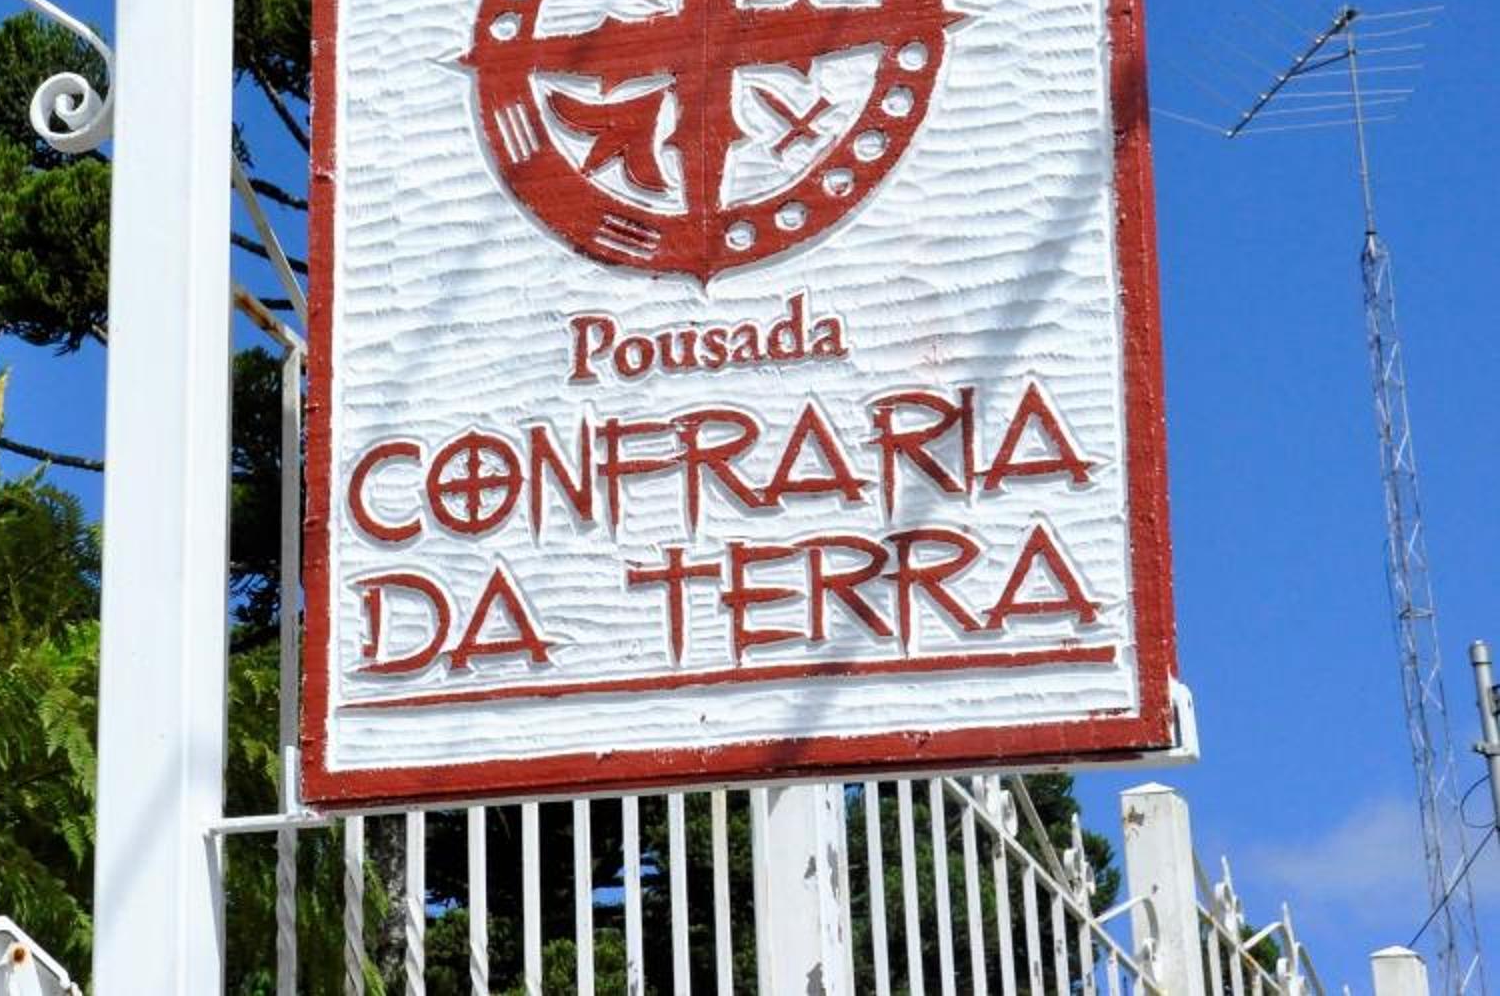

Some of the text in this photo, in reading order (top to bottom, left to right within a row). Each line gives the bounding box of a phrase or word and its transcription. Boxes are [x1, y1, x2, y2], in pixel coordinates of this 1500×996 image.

[569, 293, 848, 383] Pousada
[348, 382, 1096, 542] CONFRARIA
[354, 566, 555, 676] DA
